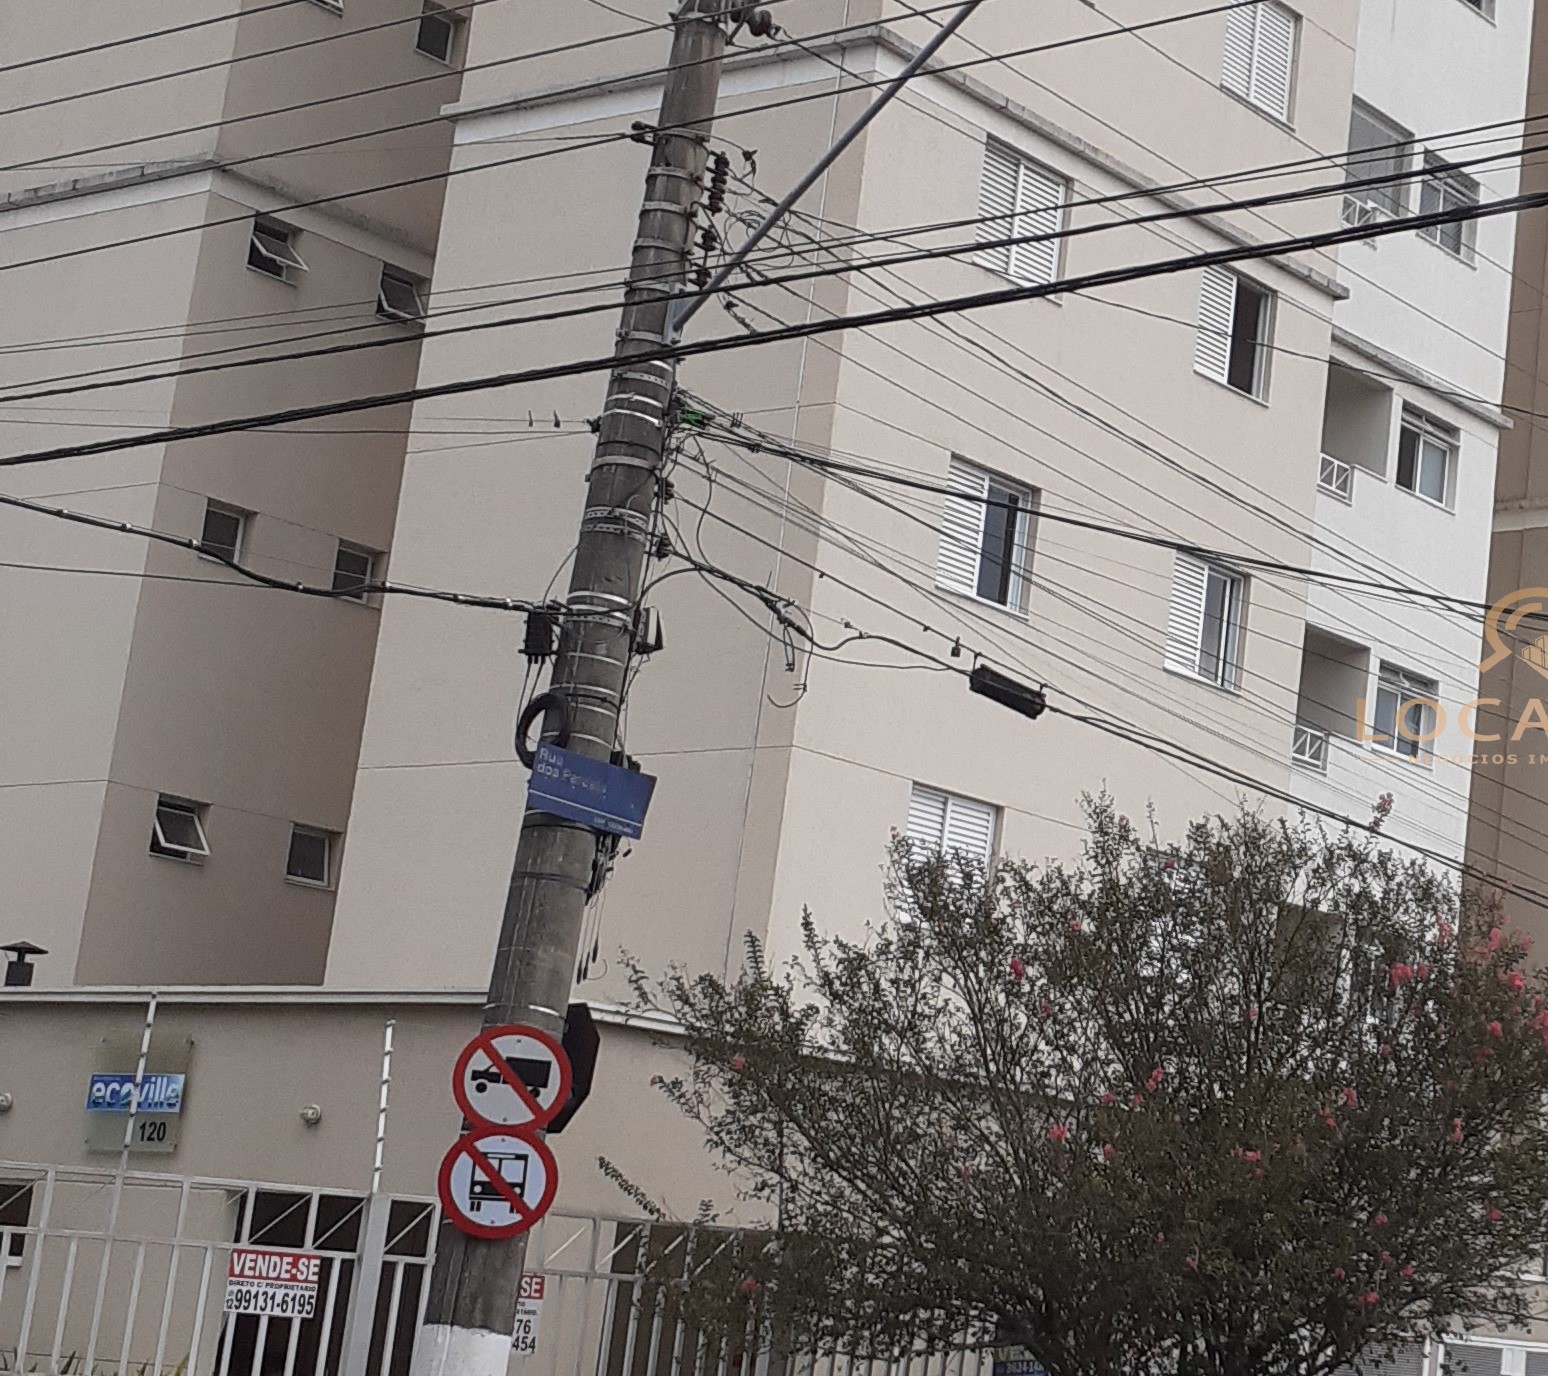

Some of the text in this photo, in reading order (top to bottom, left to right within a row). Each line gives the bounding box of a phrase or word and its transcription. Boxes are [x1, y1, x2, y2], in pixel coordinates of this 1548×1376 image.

[140, 1122, 166, 1142] 120
[232, 1252, 321, 1281] VENDE-SE
[234, 1289, 315, 1316] 99131-6195
